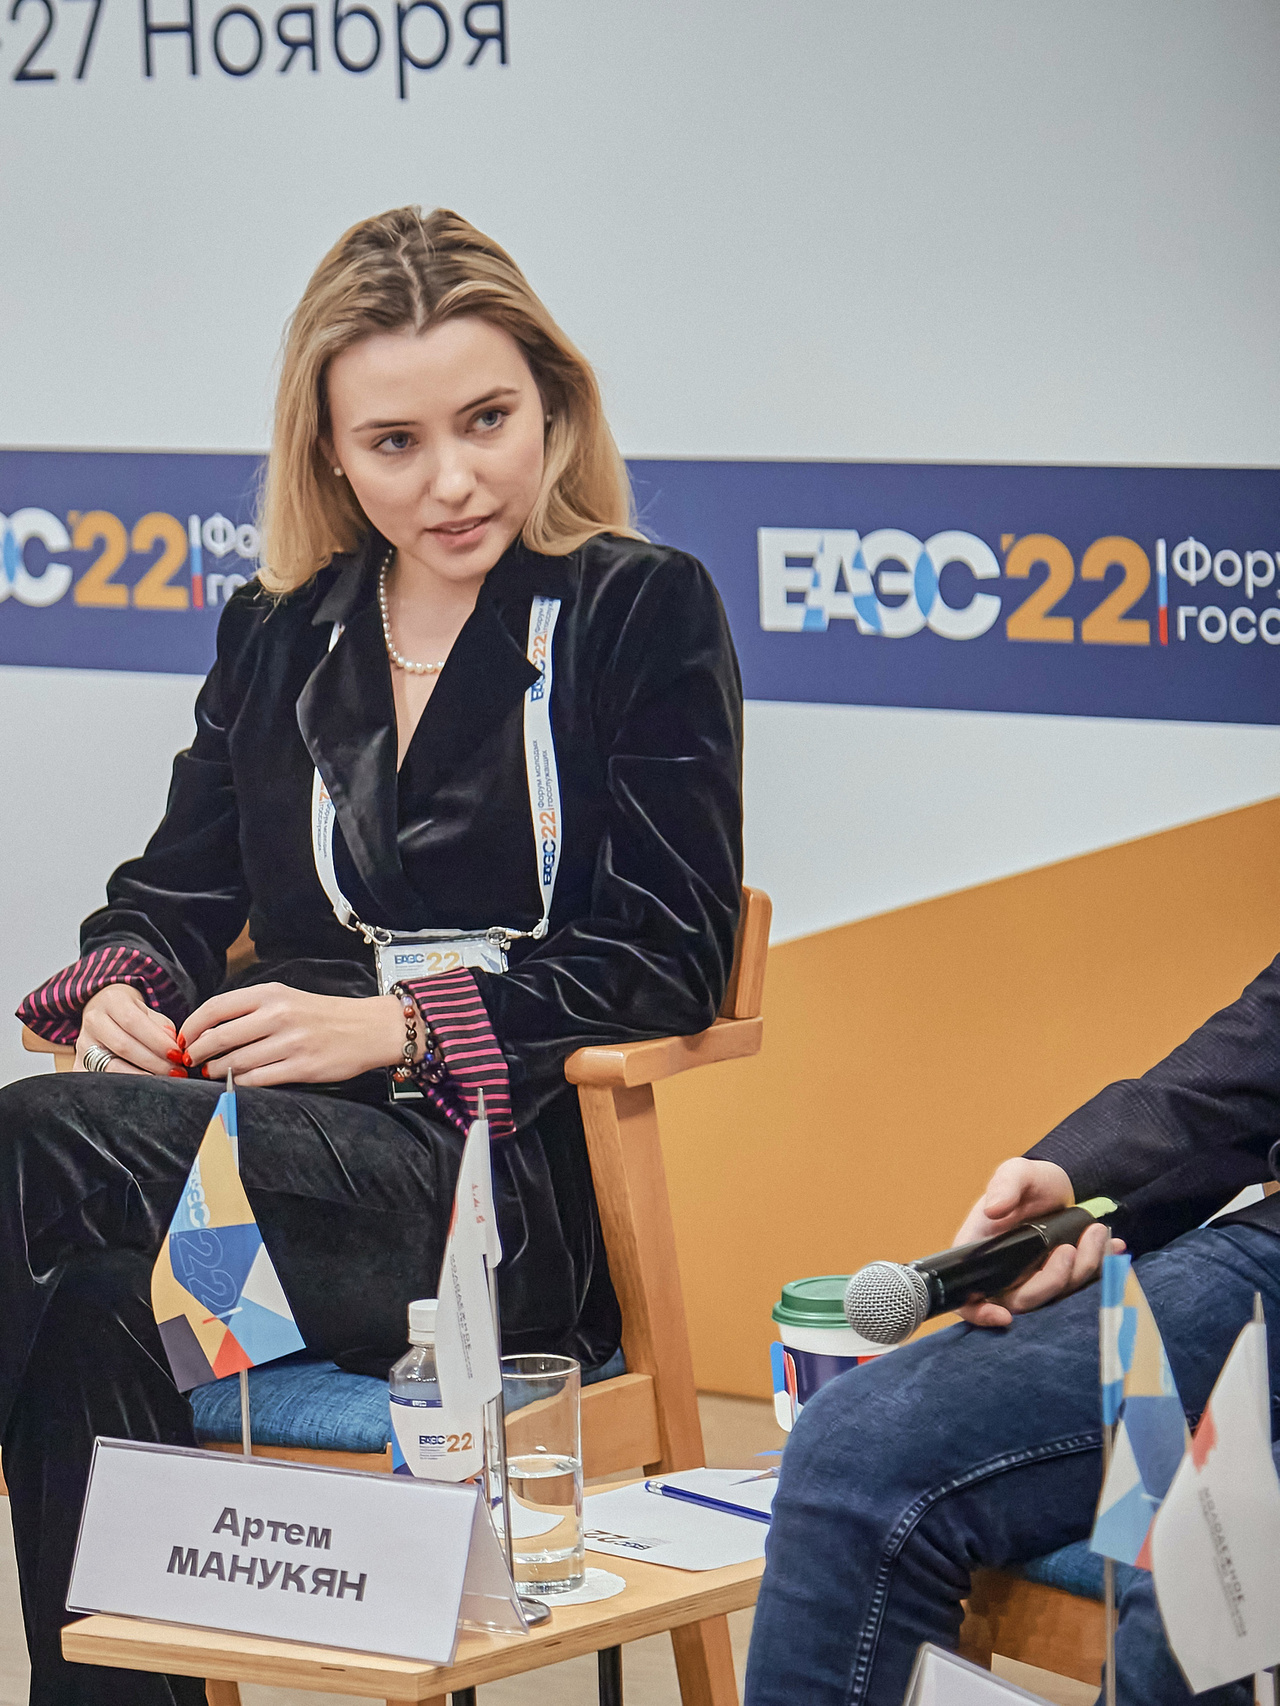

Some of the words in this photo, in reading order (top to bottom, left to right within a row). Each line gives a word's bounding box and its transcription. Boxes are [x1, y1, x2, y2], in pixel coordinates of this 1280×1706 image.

[142, 0, 507, 99] Ноября
[212, 1506, 333, 1551] Артем
[166, 1545, 368, 1602] МАНУКЯН
